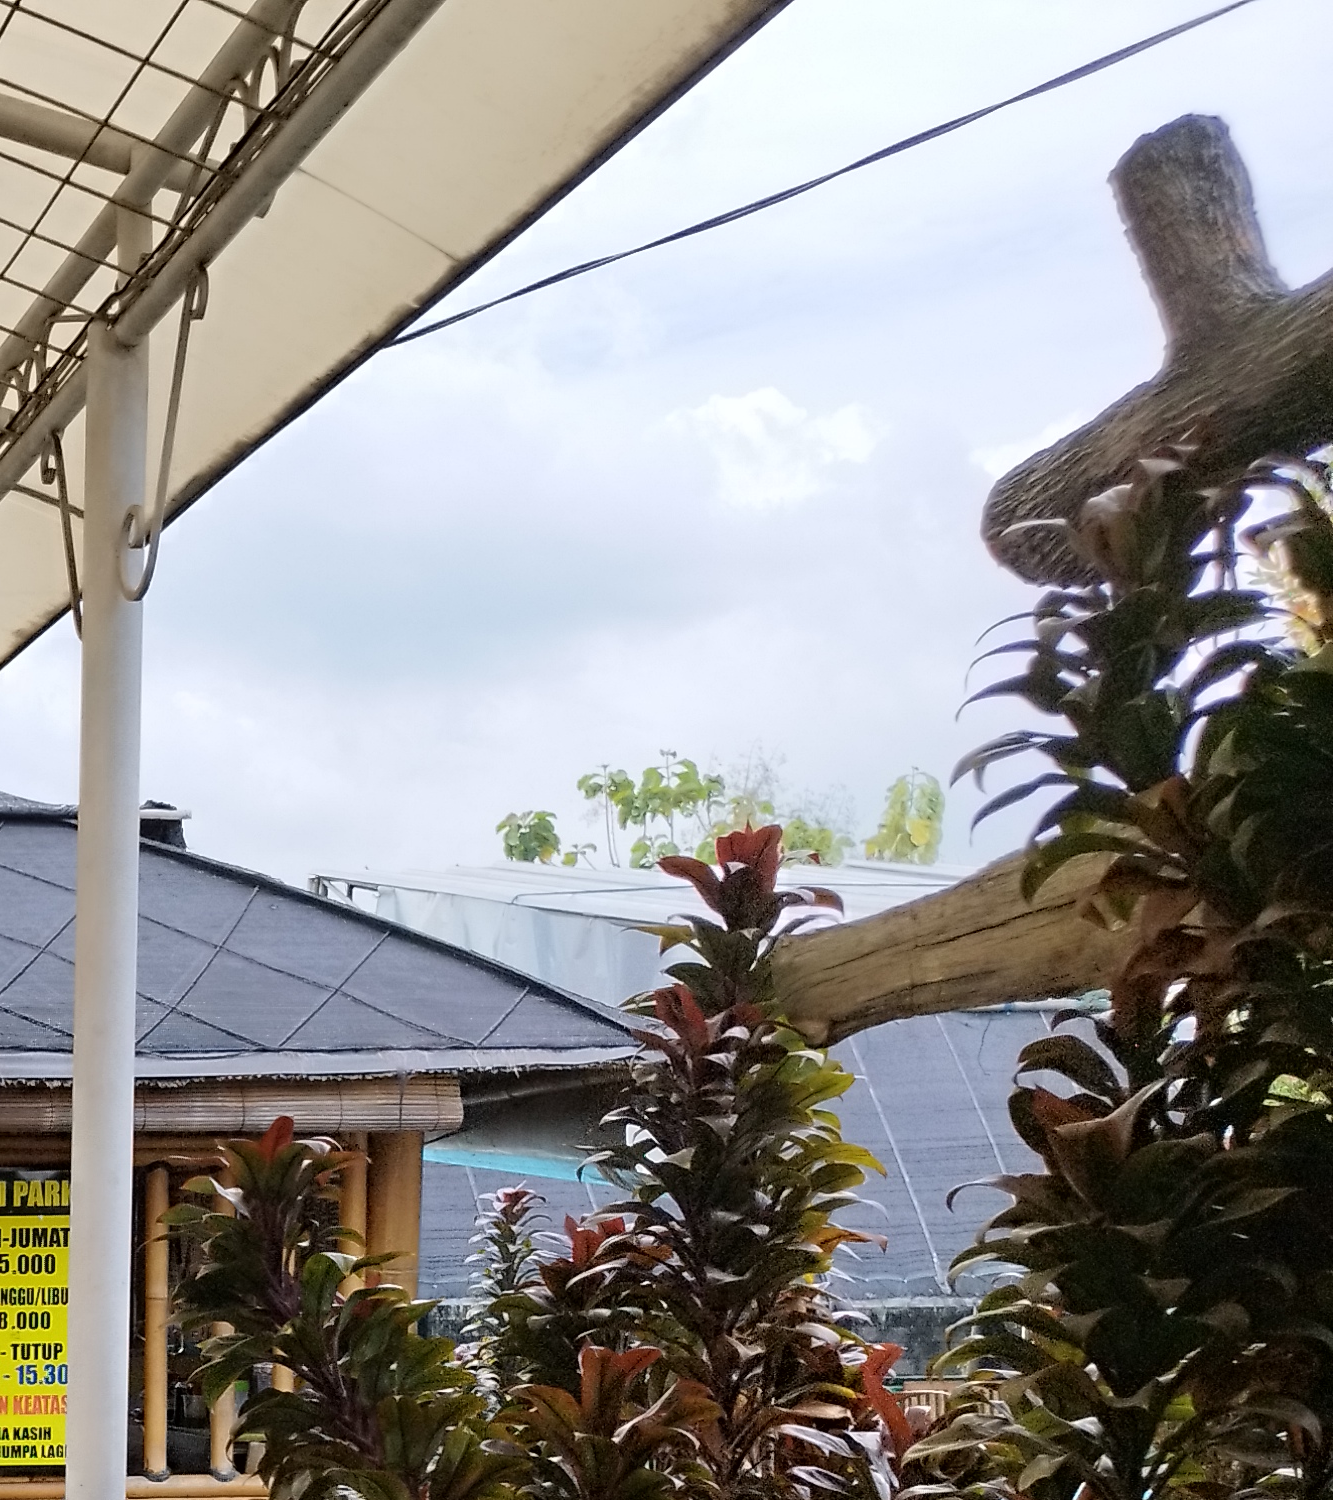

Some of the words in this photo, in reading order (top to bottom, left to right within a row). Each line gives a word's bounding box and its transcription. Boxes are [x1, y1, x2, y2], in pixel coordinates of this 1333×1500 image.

[11, 1343, 63, 1361] TUTUP
[15, 1364, 68, 1385] 15.30
[13, 1427, 52, 1441] KASIH
